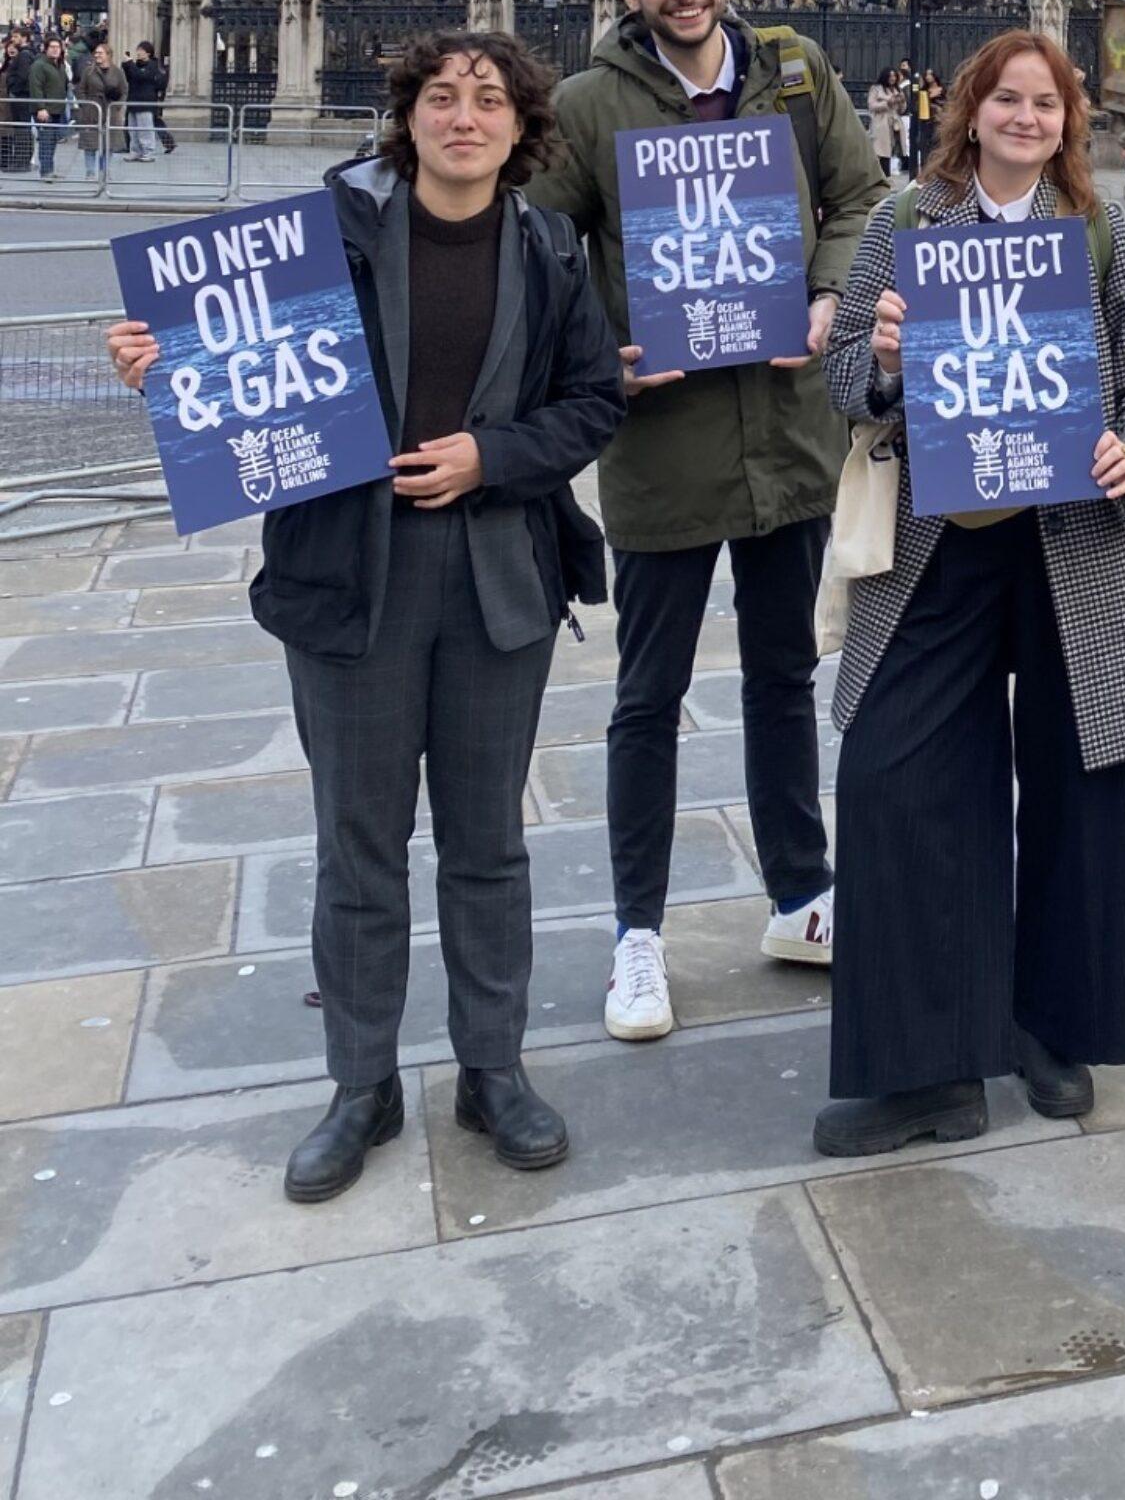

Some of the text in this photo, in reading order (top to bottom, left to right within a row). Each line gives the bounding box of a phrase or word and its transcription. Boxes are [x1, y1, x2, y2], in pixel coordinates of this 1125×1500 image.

[635, 129, 771, 178] PROTECT
[675, 173, 742, 231] UK
[147, 210, 305, 292] NO NEW
[651, 225, 776, 293] SEAS
[915, 232, 1063, 286] PROTECT
[194, 270, 295, 355] OIL
[717, 301, 744, 313] OCEAN
[719, 310, 757, 323] ALLIANCE
[959, 282, 1031, 349] UK
[719, 320, 752, 333] AGAINST
[720, 329, 761, 343] OFFSHORE
[721, 340, 757, 354] DRILLING
[170, 329, 348, 431] & GAS
[932, 344, 1069, 419] SEAS
[271, 423, 304, 443] OCEAN
[274, 431, 322, 455] ALLIANCE
[1005, 431, 1034, 446] OCEAN
[276, 445, 317, 467] AGAINST
[1006, 442, 1049, 457] ALLIANCE
[279, 454, 331, 478] OFFSHORE
[1008, 453, 1044, 469] AGAINST
[281, 468, 327, 490] DRILLING
[1008, 465, 1054, 480] OFFSHORE
[1009, 477, 1049, 492] DRILLING
